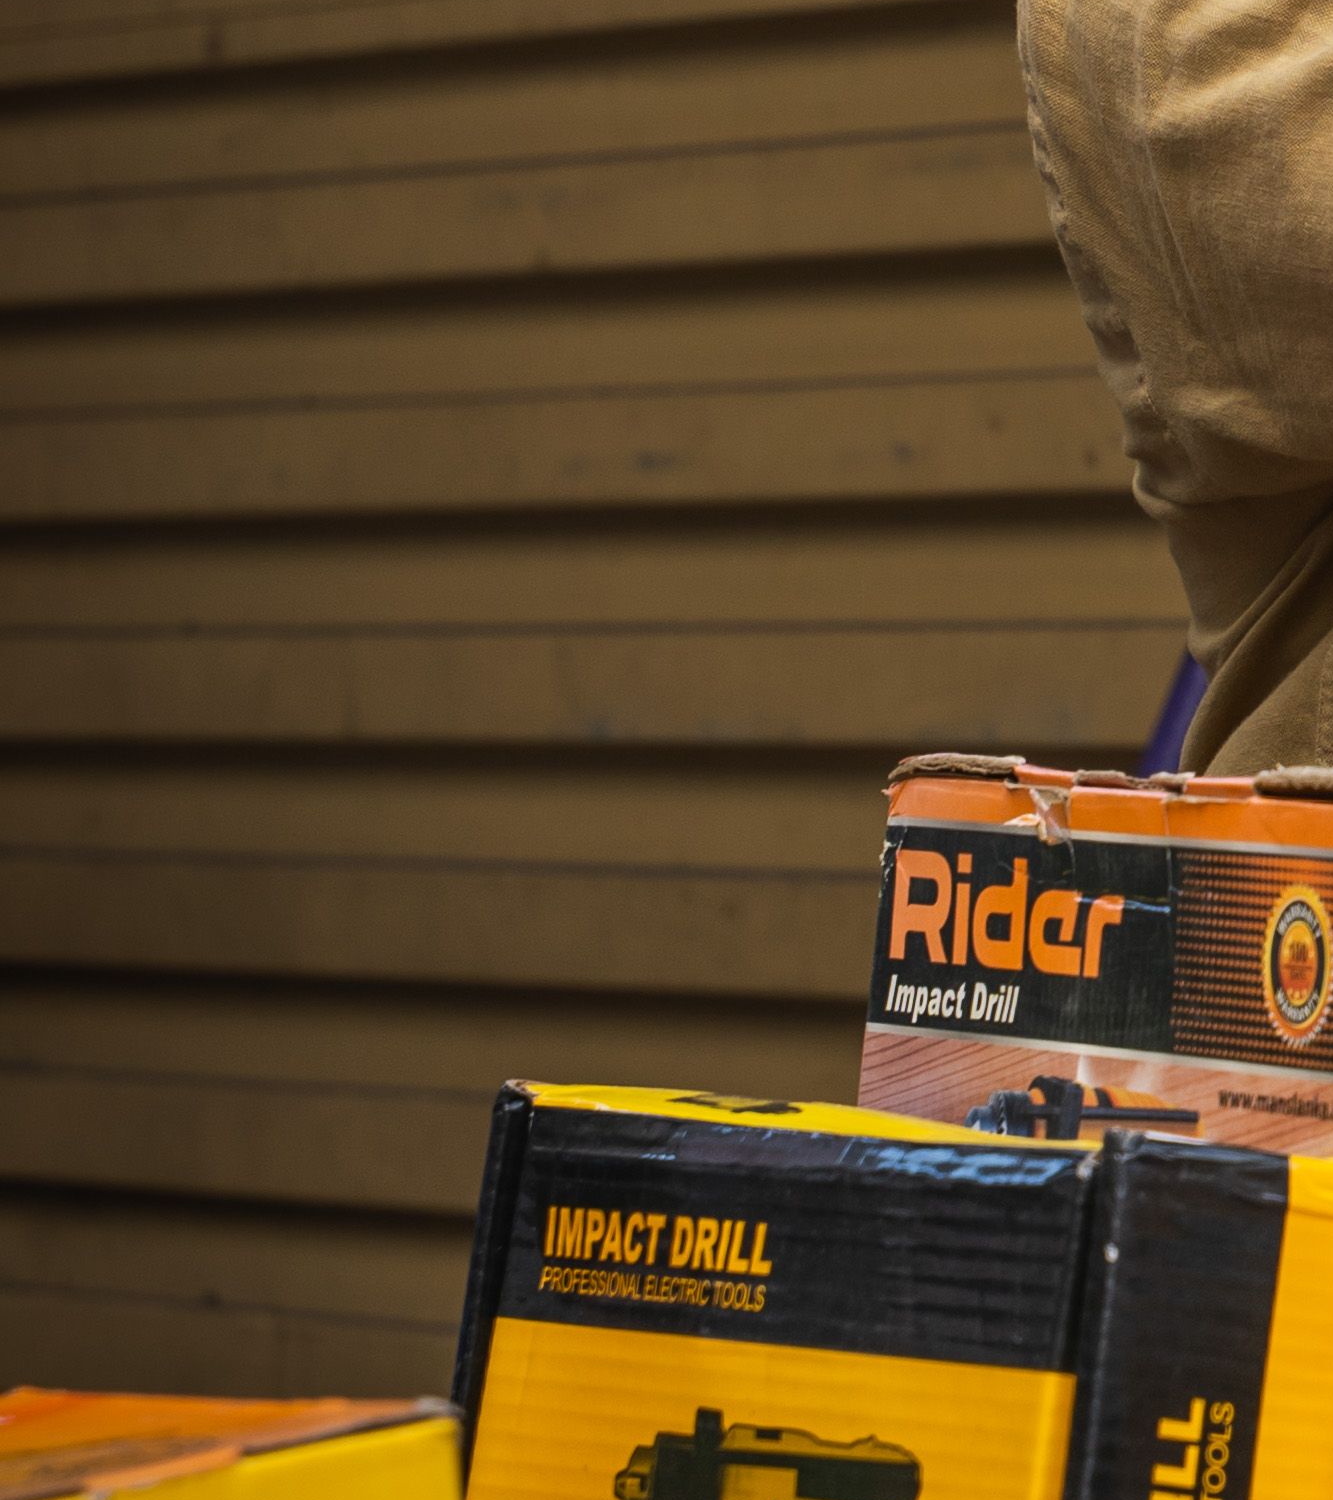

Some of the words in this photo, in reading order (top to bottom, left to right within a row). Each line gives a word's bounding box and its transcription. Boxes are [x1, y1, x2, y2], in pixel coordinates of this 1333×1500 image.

[888, 848, 1129, 979] Rider
[886, 974, 967, 1023] Impact
[969, 979, 1020, 1027] Drill
[542, 1206, 667, 1269] IMPACT
[670, 1216, 773, 1277] DRILL
[538, 1266, 641, 1300] PROFESSIONAL
[644, 1273, 710, 1306] ELECTRIC
[713, 1281, 767, 1313] TOOLS
